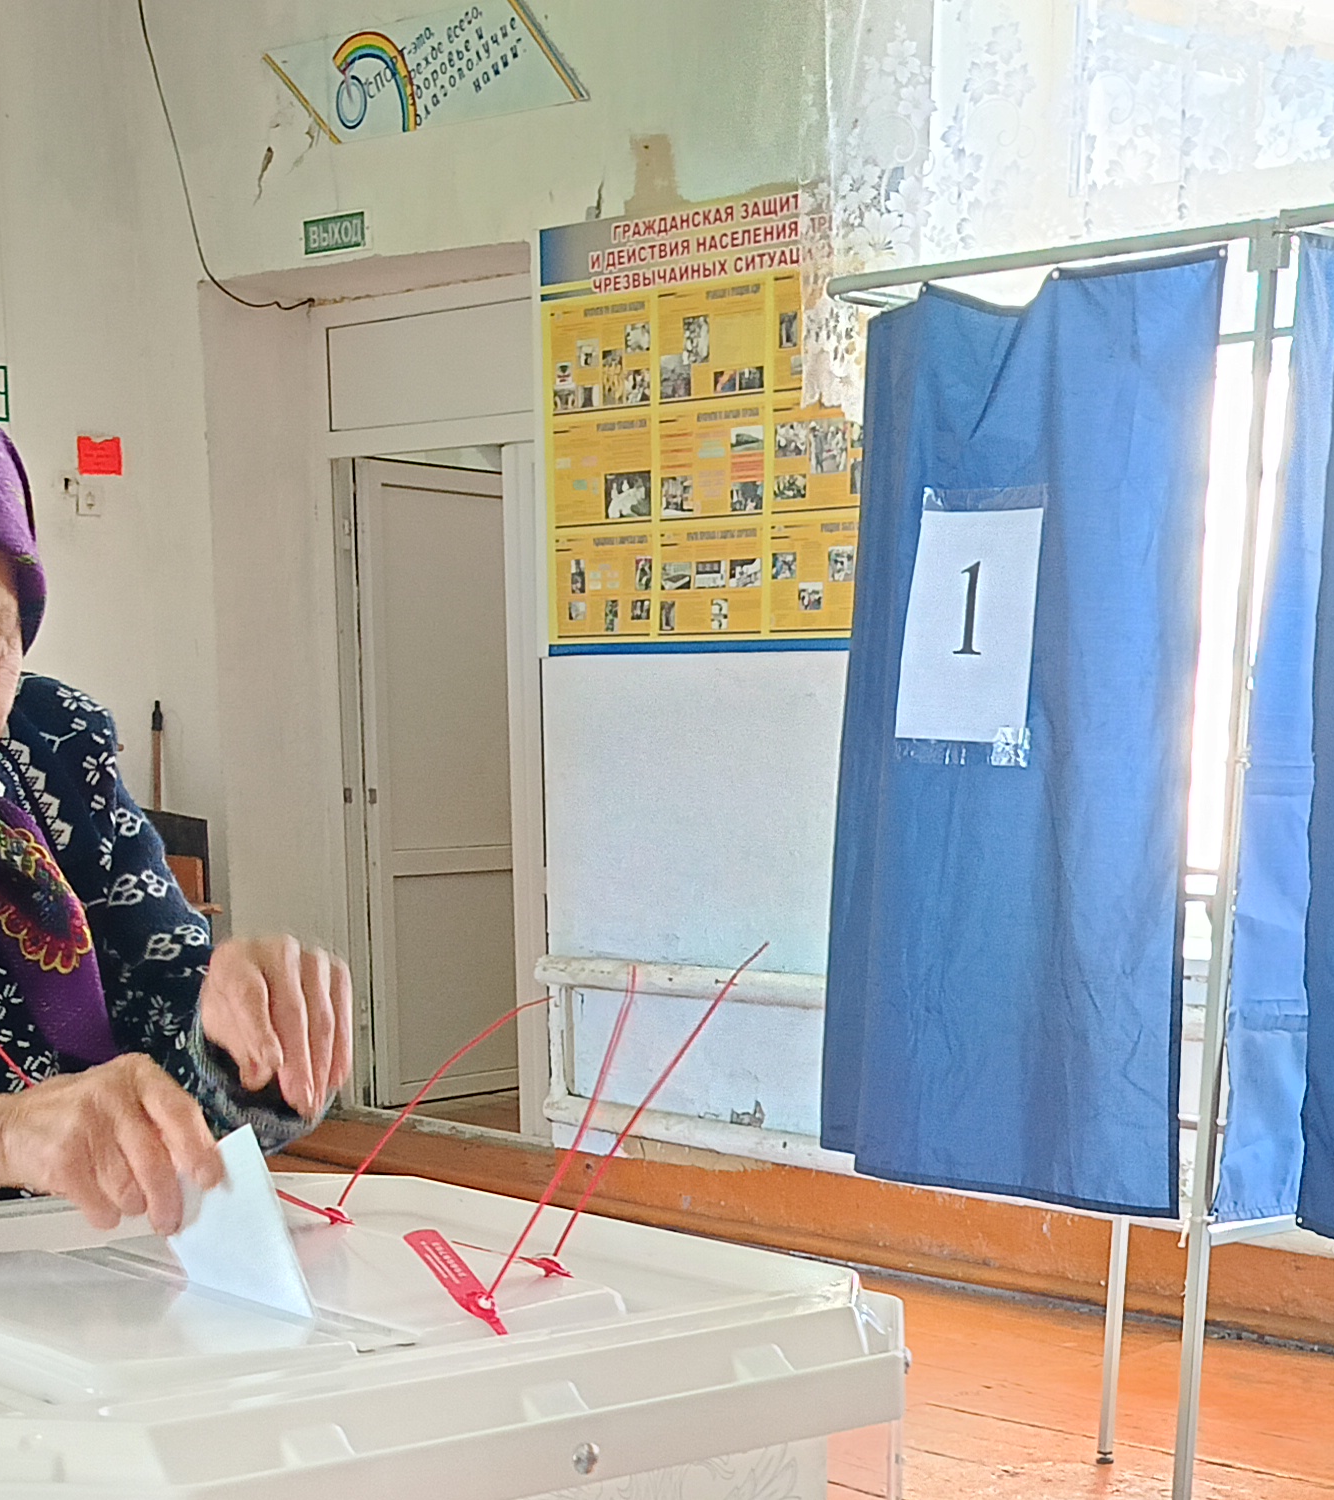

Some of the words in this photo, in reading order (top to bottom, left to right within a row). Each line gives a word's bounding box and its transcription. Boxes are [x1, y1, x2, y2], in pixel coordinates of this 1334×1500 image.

[308, 220, 363, 249] ВЫХОД
[612, 205, 734, 241] ГРАЖДАНСКАЯ
[740, 193, 800, 220] ЗАЩИТ
[590, 254, 602, 271] И
[605, 239, 691, 271] ДЕЙСТВИЯ
[696, 220, 799, 253] НАСЕЛЕНИЯ
[592, 259, 728, 293] ЧРЕЗВЫЧАЙНЫХ
[952, 560, 983, 656] 1
